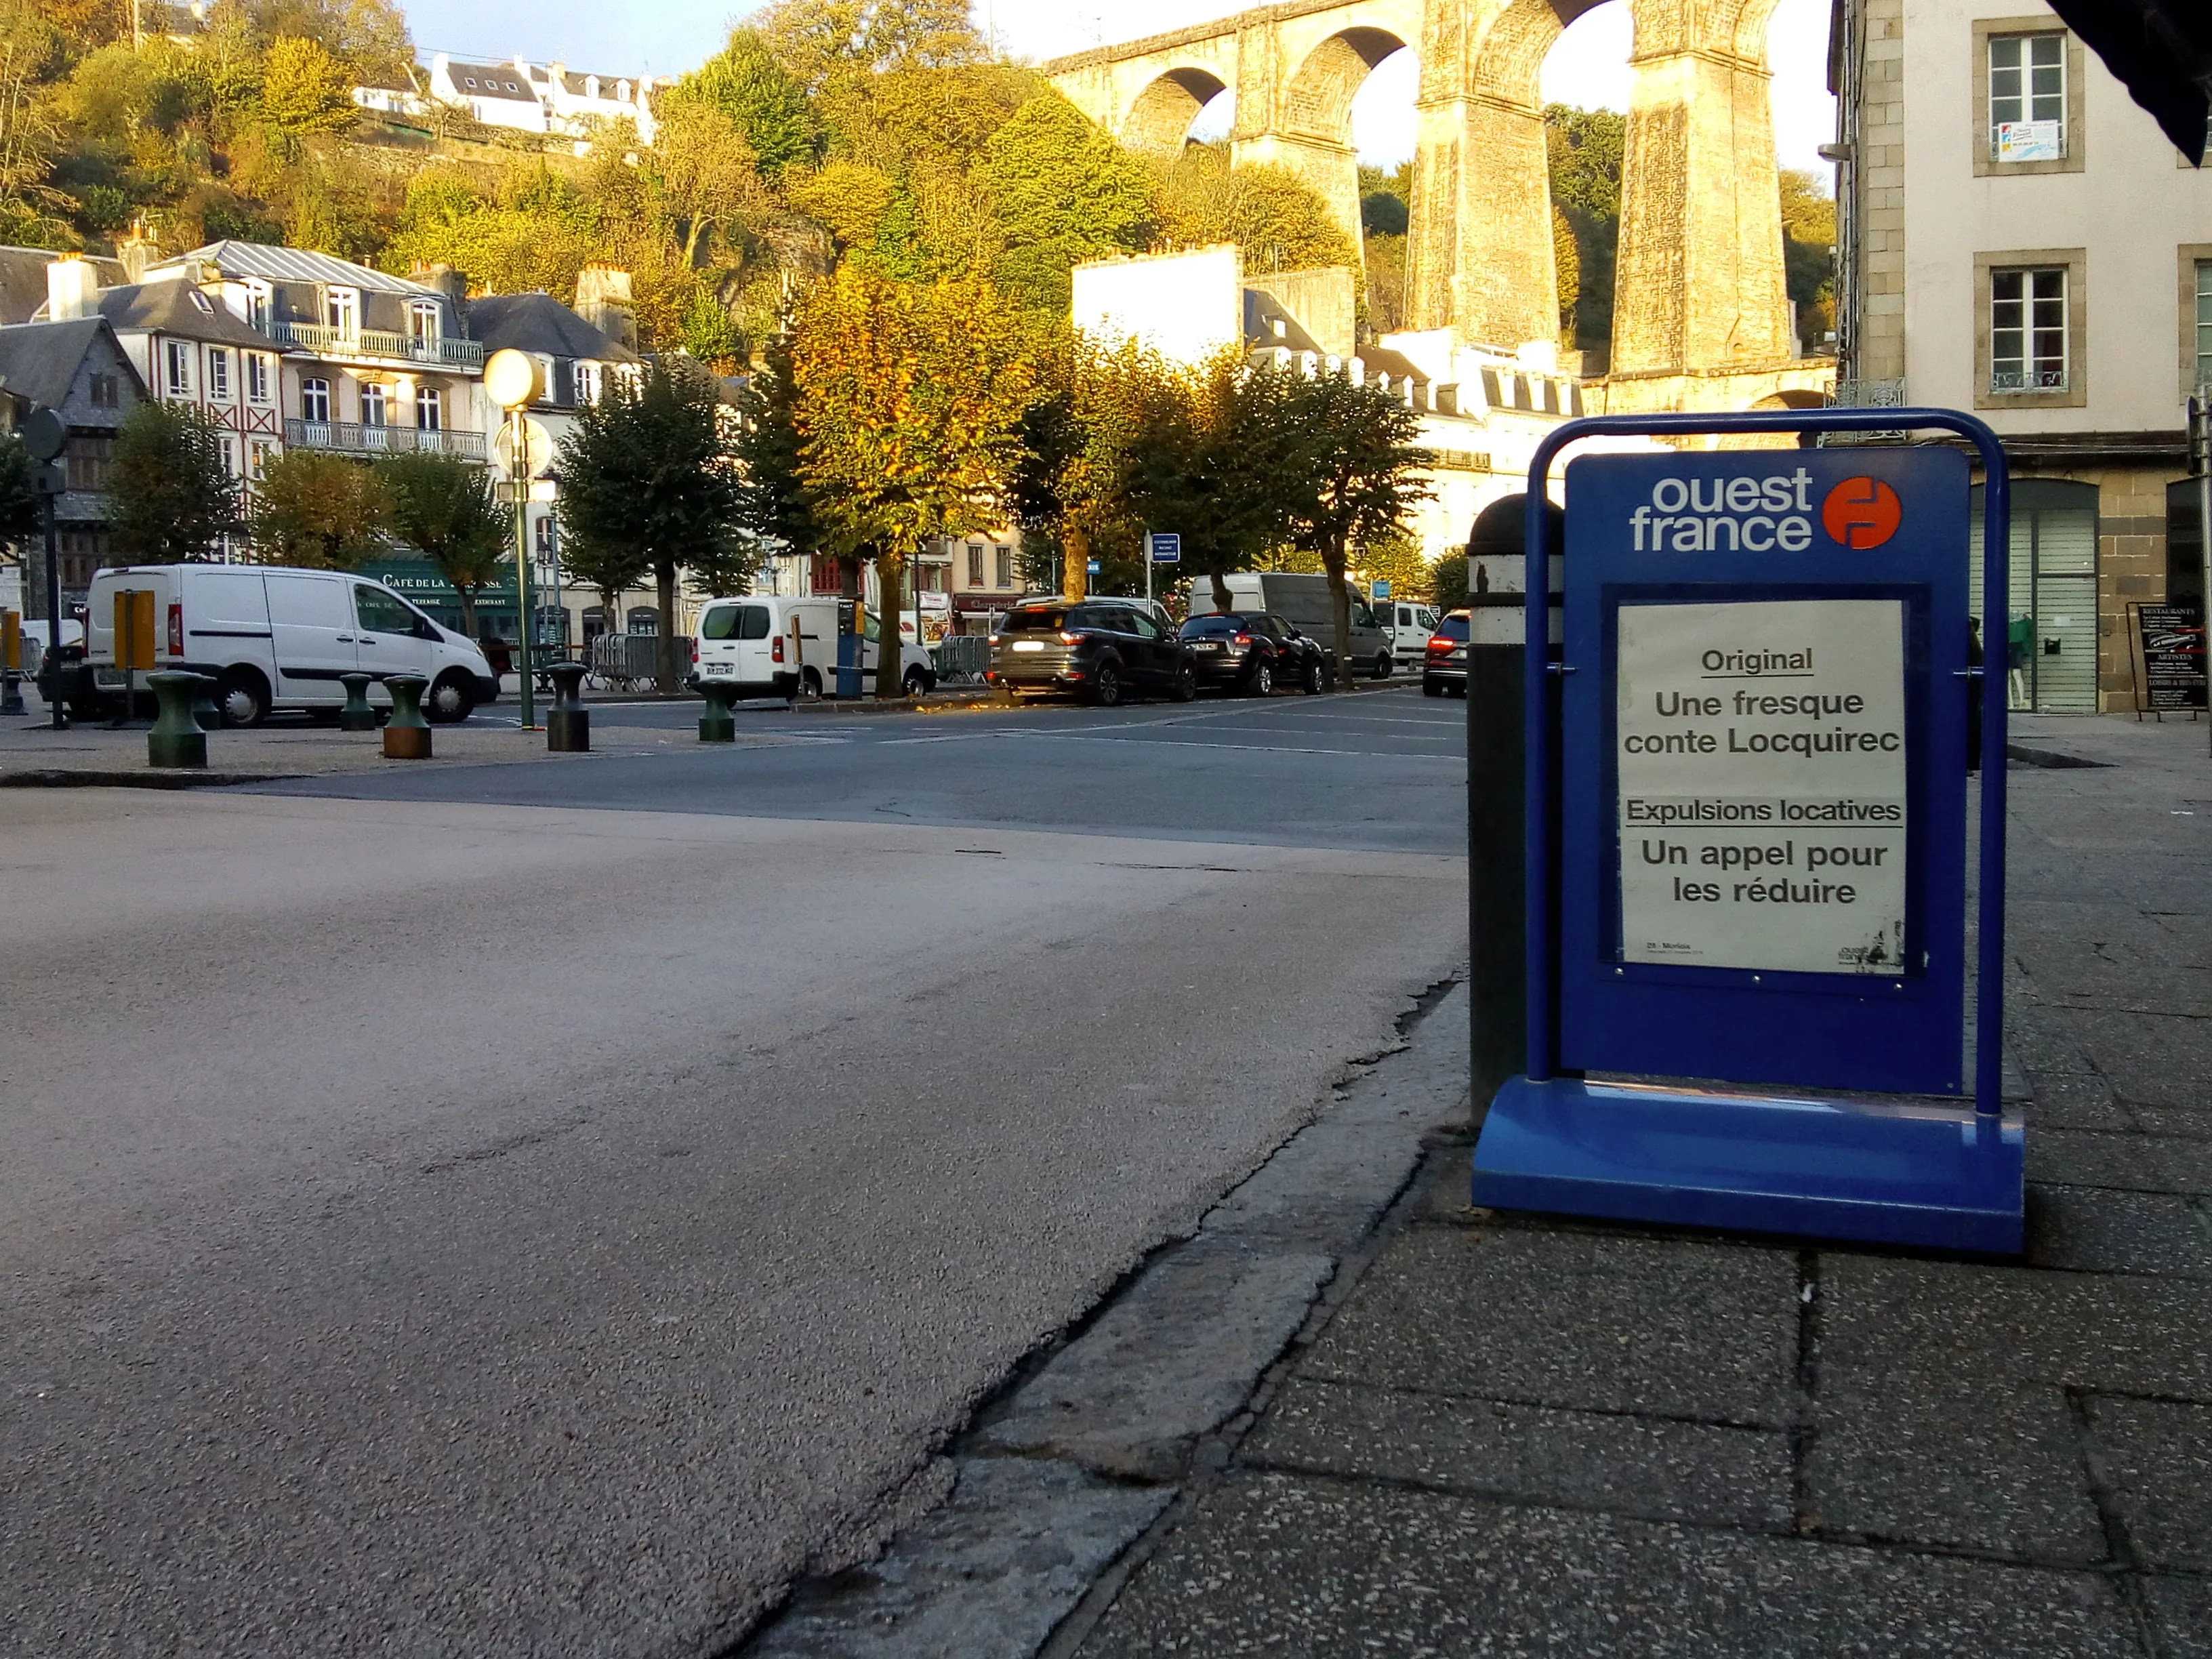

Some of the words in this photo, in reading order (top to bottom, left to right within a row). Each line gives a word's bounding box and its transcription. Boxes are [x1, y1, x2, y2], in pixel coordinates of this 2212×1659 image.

[1653, 468, 1813, 512] ouest
[1629, 506, 1812, 552] france
[416, 579, 429, 588] DE
[432, 579, 445, 588] LA
[1701, 647, 1813, 676] Original
[1656, 691, 1722, 717] Une
[1732, 689, 1865, 721] fresque
[1624, 730, 1717, 754] conte
[1728, 726, 1901, 758] Locquirec
[1626, 799, 1773, 826] Expulsions
[1780, 799, 1902, 821] locatives
[1642, 839, 1688, 865] Un
[1700, 840, 1793, 872] appel
[1807, 846, 1888, 873] pour
[1673, 876, 1721, 902] les
[1734, 876, 1857, 904] réduire
